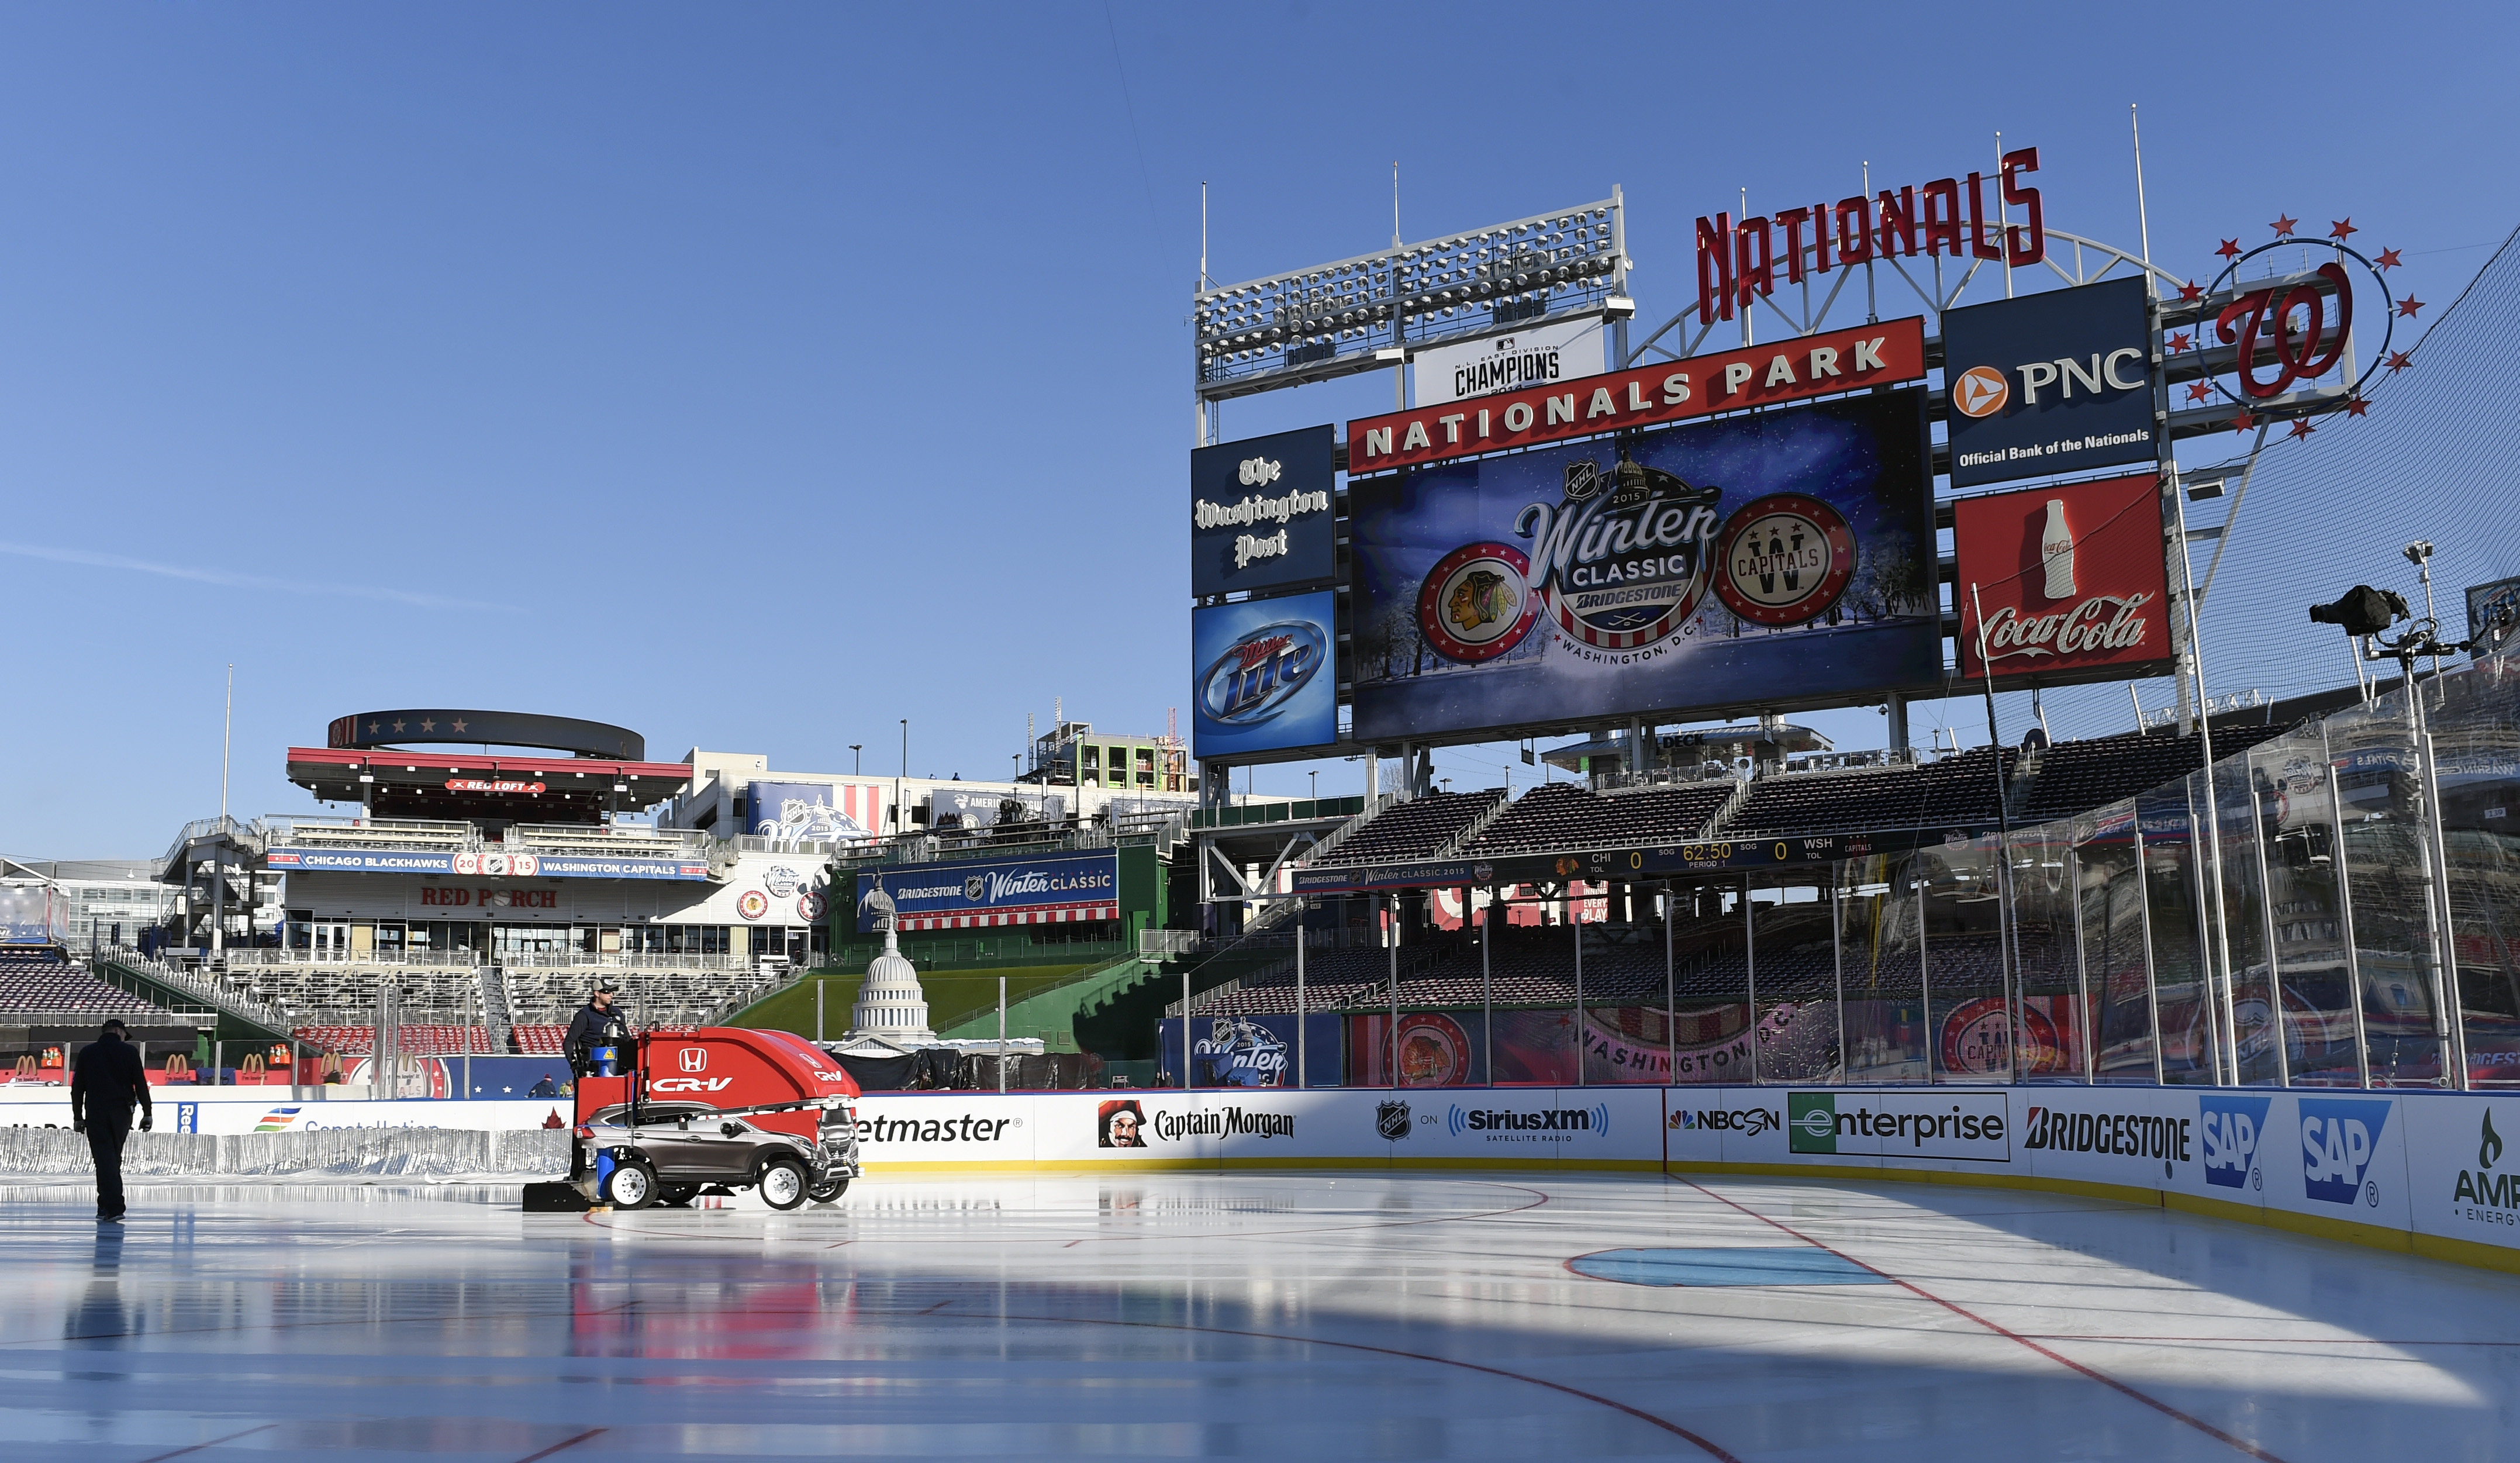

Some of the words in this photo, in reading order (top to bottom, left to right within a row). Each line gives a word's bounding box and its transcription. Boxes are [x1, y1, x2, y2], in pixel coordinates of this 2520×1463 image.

[1696, 146, 2045, 326] NATIONALS
[1455, 361, 1475, 370] N.L.
[1480, 352, 1506, 362] EAST
[1511, 345, 1559, 355] DIVISION
[1455, 352, 1559, 397] CHAMPIONS
[2015, 347, 2146, 405] PNC
[1366, 372, 1691, 457] NATIONALS
[1725, 336, 1886, 394] PARK
[1490, 385, 1523, 396] 2014
[1959, 449, 2005, 467] Official
[2009, 444, 2042, 460] Bank
[2046, 441, 2059, 454] of
[2061, 440, 2082, 453] the
[2084, 429, 2149, 450] Nationals
[1238, 457, 1282, 486] The
[1570, 471, 1592, 491] NHL
[1195, 488, 1329, 530] Washington
[1613, 492, 1641, 504] 2015
[1234, 529, 1288, 570] Post
[1513, 487, 1727, 589] Winter
[1573, 555, 1686, 587] CLASSIC
[1738, 548, 1818, 577] CAPITALS
[1576, 584, 1682, 609] BRIDGESTONE
[1975, 590, 2156, 661] Coca-Cola
[1232, 633, 1294, 668] Miller
[1562, 639, 1668, 665] WASHINGTON,
[1671, 625, 1697, 646] D.C.
[1217, 644, 1311, 720] Lite
[1663, 734, 1706, 748] DECK
[494, 782, 526, 791] LOFT
[787, 808, 802, 822] NHL
[1592, 853, 1611, 863] CHI
[1630, 851, 1642, 869] 0
[1683, 843, 1731, 861] 62:50
[1775, 842, 1787, 860] 0
[1804, 838, 1832, 849] WSH
[1845, 843, 1872, 853] CAPITALS
[305, 855, 361, 866] CHICAGO
[365, 857, 448, 868] BLACKHAWKS
[543, 862, 620, 873] WASHINGTON
[623, 864, 675, 875] CAPITALS
[763, 869, 800, 886] Winter
[897, 885, 963, 900] BRIDGESTONE
[985, 868, 1051, 904] Winter
[1050, 875, 1111, 891] CLASSIC
[1298, 875, 1348, 885] BRIDGESTONE
[1362, 868, 1399, 885] Winter
[1401, 869, 1441, 878] CLASSIC
[1444, 867, 1465, 875] 2015
[420, 887, 470, 906] RED
[1583, 898, 1607, 908] EVERY
[1583, 908, 1608, 921] PLAY
[1217, 1024, 1229, 1037] NHL
[652, 1077, 733, 1092] CR-V
[813, 1070, 842, 1081] CR-V
[1154, 1107, 1220, 1141] Captain
[1219, 1106, 1294, 1140] Morgan
[1380, 1110, 1408, 1138] NHL
[1420, 1114, 1438, 1125] ON
[1697, 1107, 1780, 1137] NBCSN
[1791, 1106, 2004, 1147] enterprise
[2024, 1106, 2191, 1162] BRIDGESTONE
[2202, 1109, 2255, 1172] SAP
[2302, 1116, 2370, 1183] SAP
